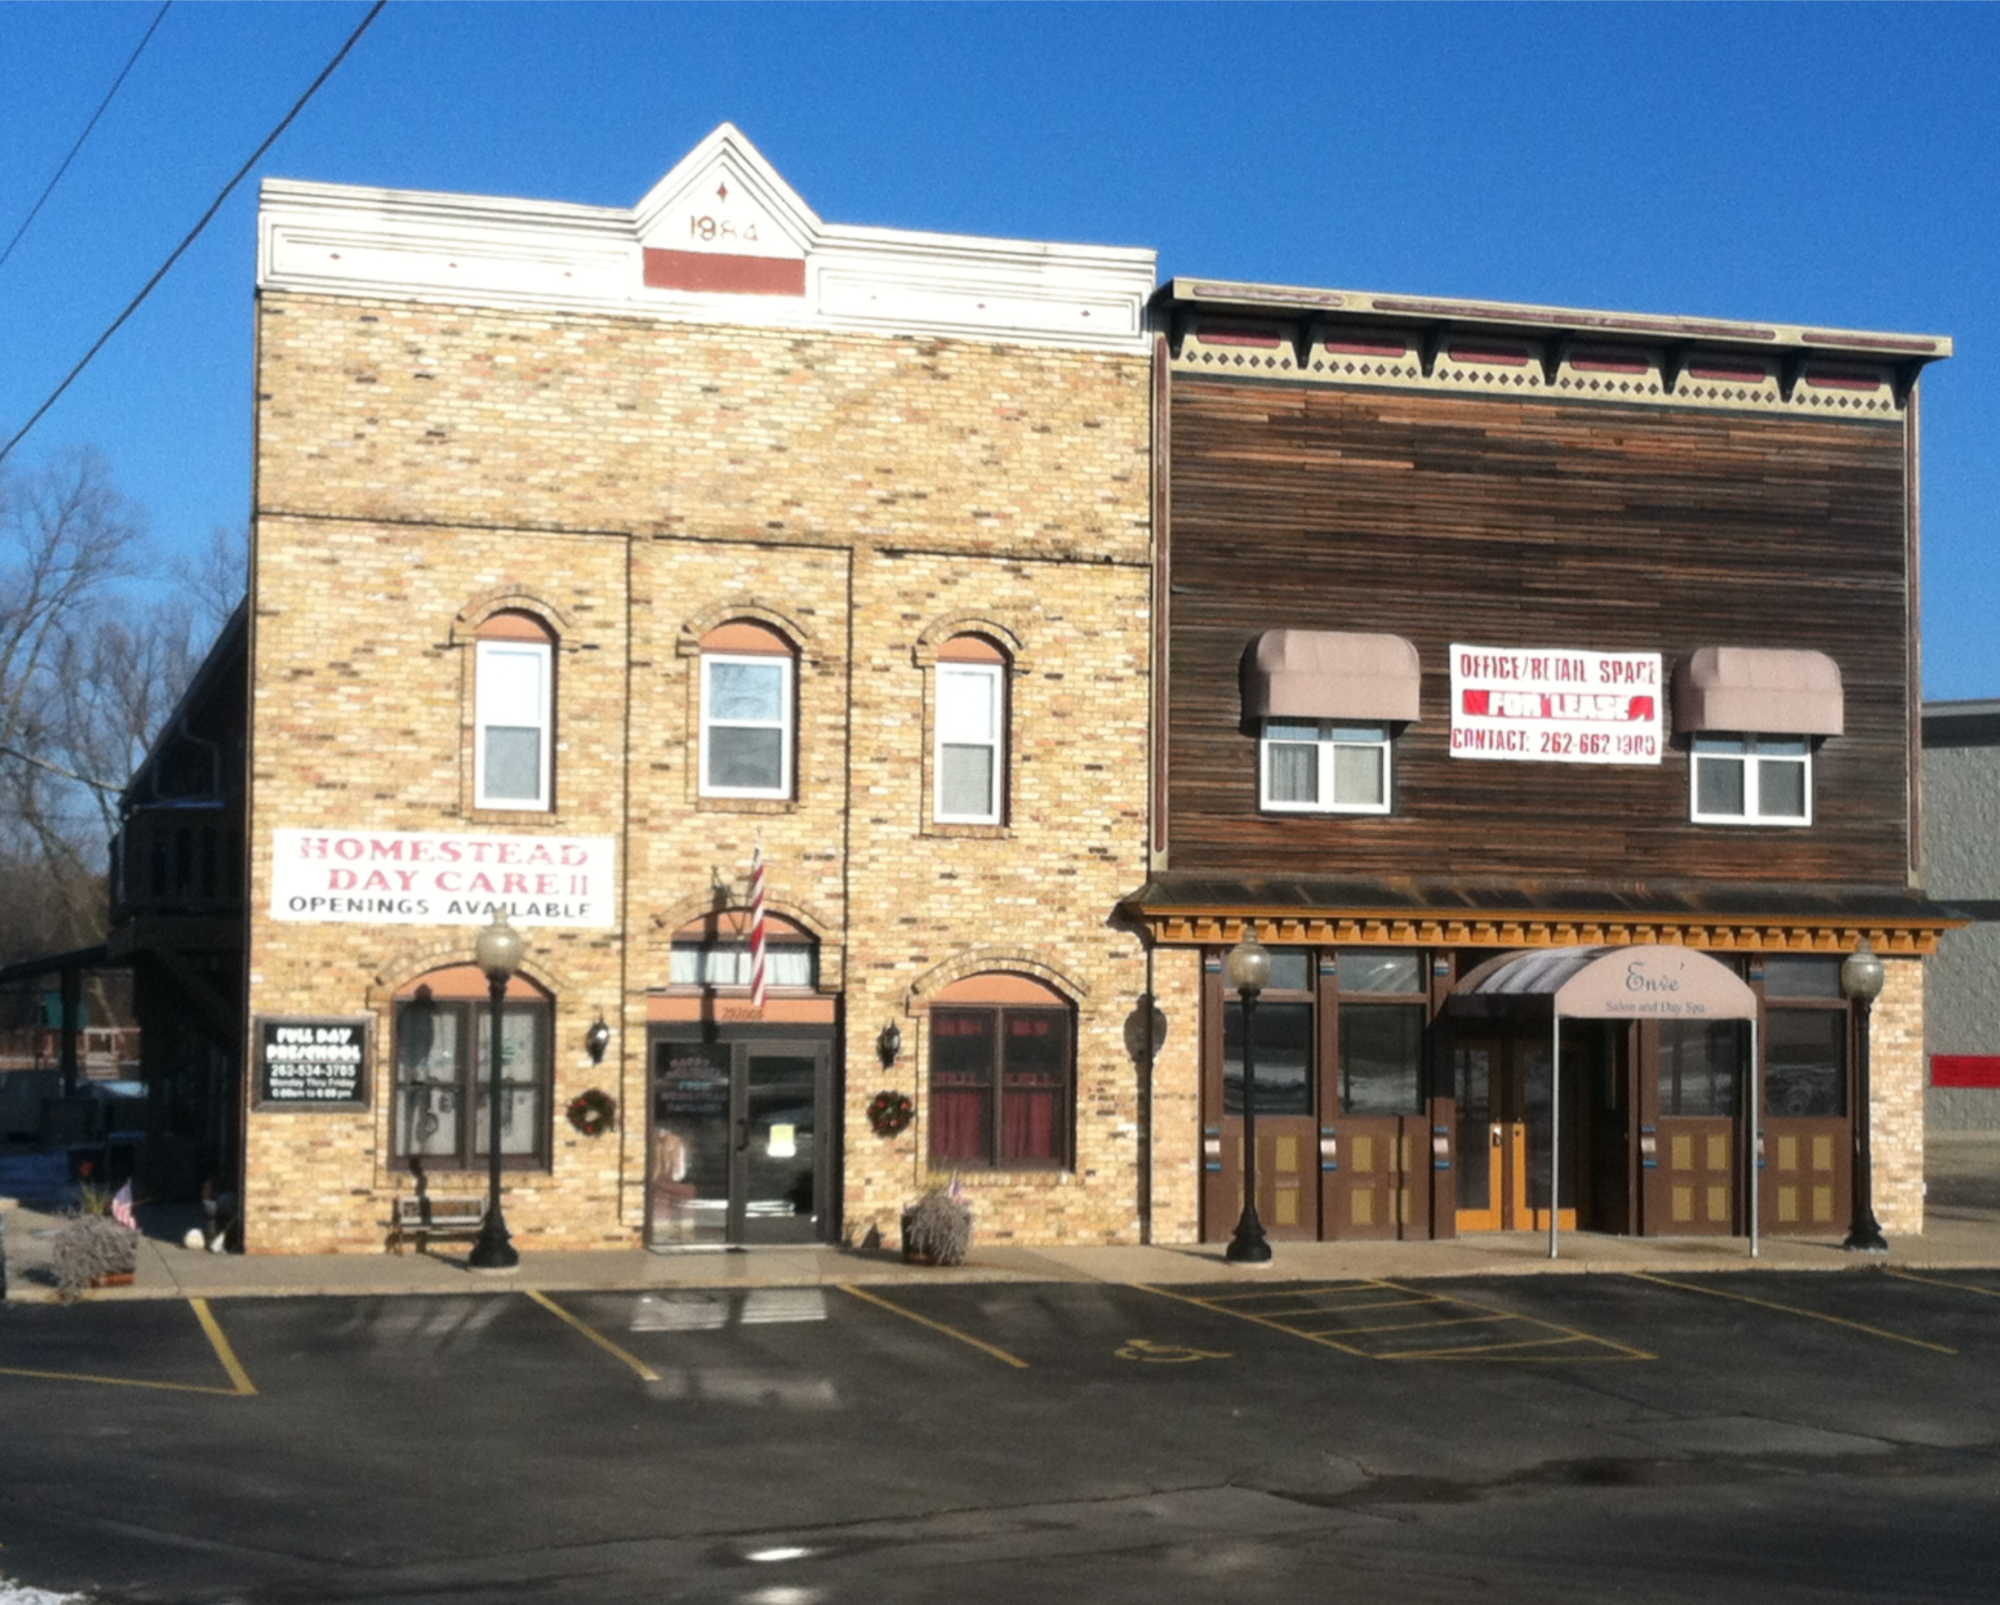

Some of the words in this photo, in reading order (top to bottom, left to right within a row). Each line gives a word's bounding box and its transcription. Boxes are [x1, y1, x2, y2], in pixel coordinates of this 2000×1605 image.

[1599, 659, 1656, 685] SPACE
[1489, 692, 1541, 716] FOR
[1551, 693, 1630, 720] LEASE
[1452, 728, 1530, 752] CONTACT:
[299, 836, 588, 867] HOMESTEAD
[327, 868, 418, 893] DAY
[435, 870, 559, 897] CARE
[288, 896, 429, 914] OPENINGS
[447, 899, 591, 919] AVAILABLE
[1606, 1001, 1635, 1012] Salon
[1638, 1001, 1657, 1012] and
[1661, 1001, 1681, 1014] Day
[1685, 1001, 1705, 1014] Spa
[277, 1028, 314, 1043] FULL
[317, 1029, 352, 1044] DAY
[267, 1045, 361, 1060] PRESCHOOL
